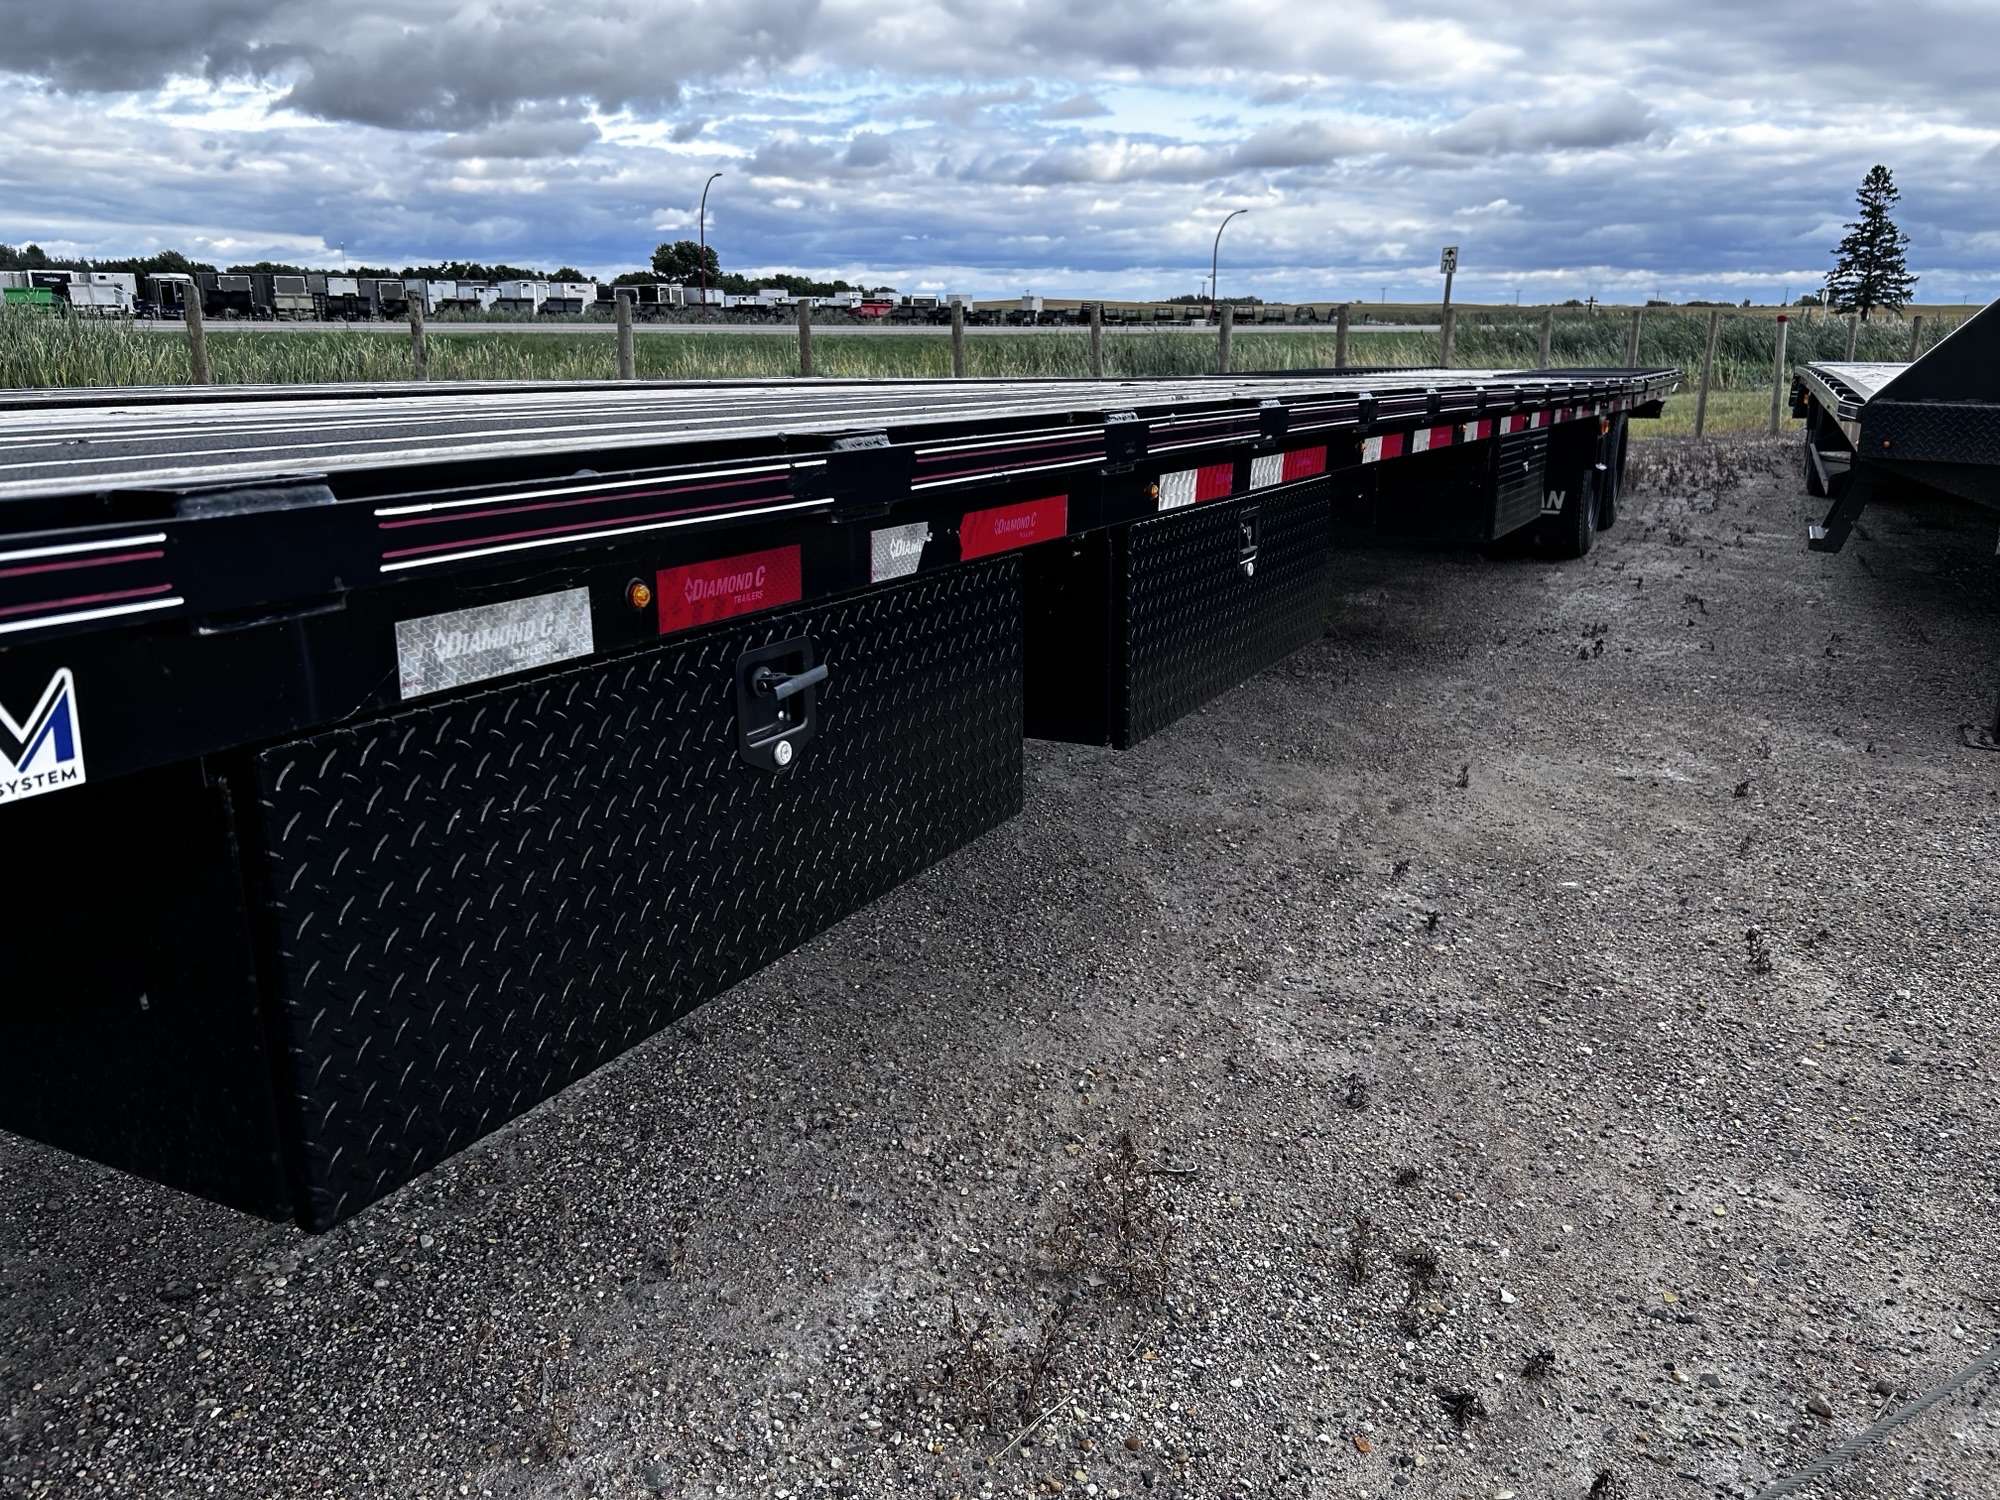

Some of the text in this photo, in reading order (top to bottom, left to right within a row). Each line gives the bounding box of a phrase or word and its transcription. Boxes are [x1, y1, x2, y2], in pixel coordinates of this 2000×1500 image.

[1442, 258, 1455, 271] 70
[997, 515, 1030, 535] DIAMOND
[1031, 511, 1038, 528] C
[692, 565, 766, 601] DIAMOND C
[734, 590, 764, 604] TRAILERS
[446, 611, 555, 658] DIAMOND C
